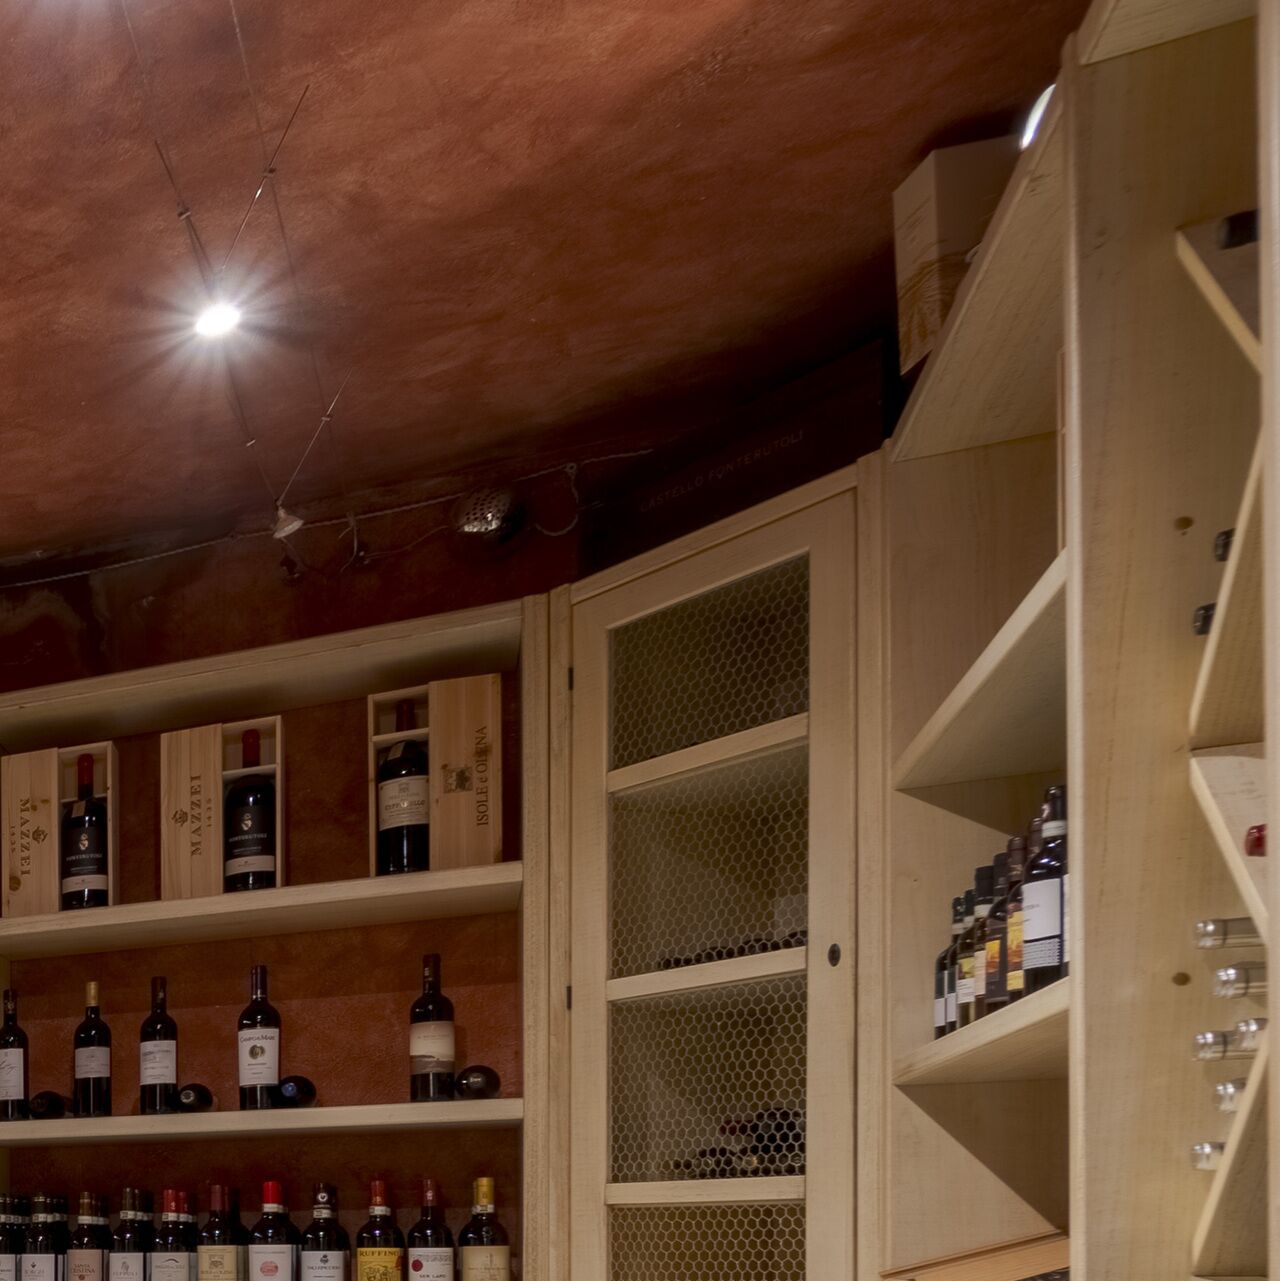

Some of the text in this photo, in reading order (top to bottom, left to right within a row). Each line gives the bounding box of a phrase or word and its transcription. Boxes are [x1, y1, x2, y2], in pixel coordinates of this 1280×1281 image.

[20, 798, 30, 875] MAZZEI
[190, 774, 202, 856] MAZZEI
[476, 786, 489, 826] ISOLE
